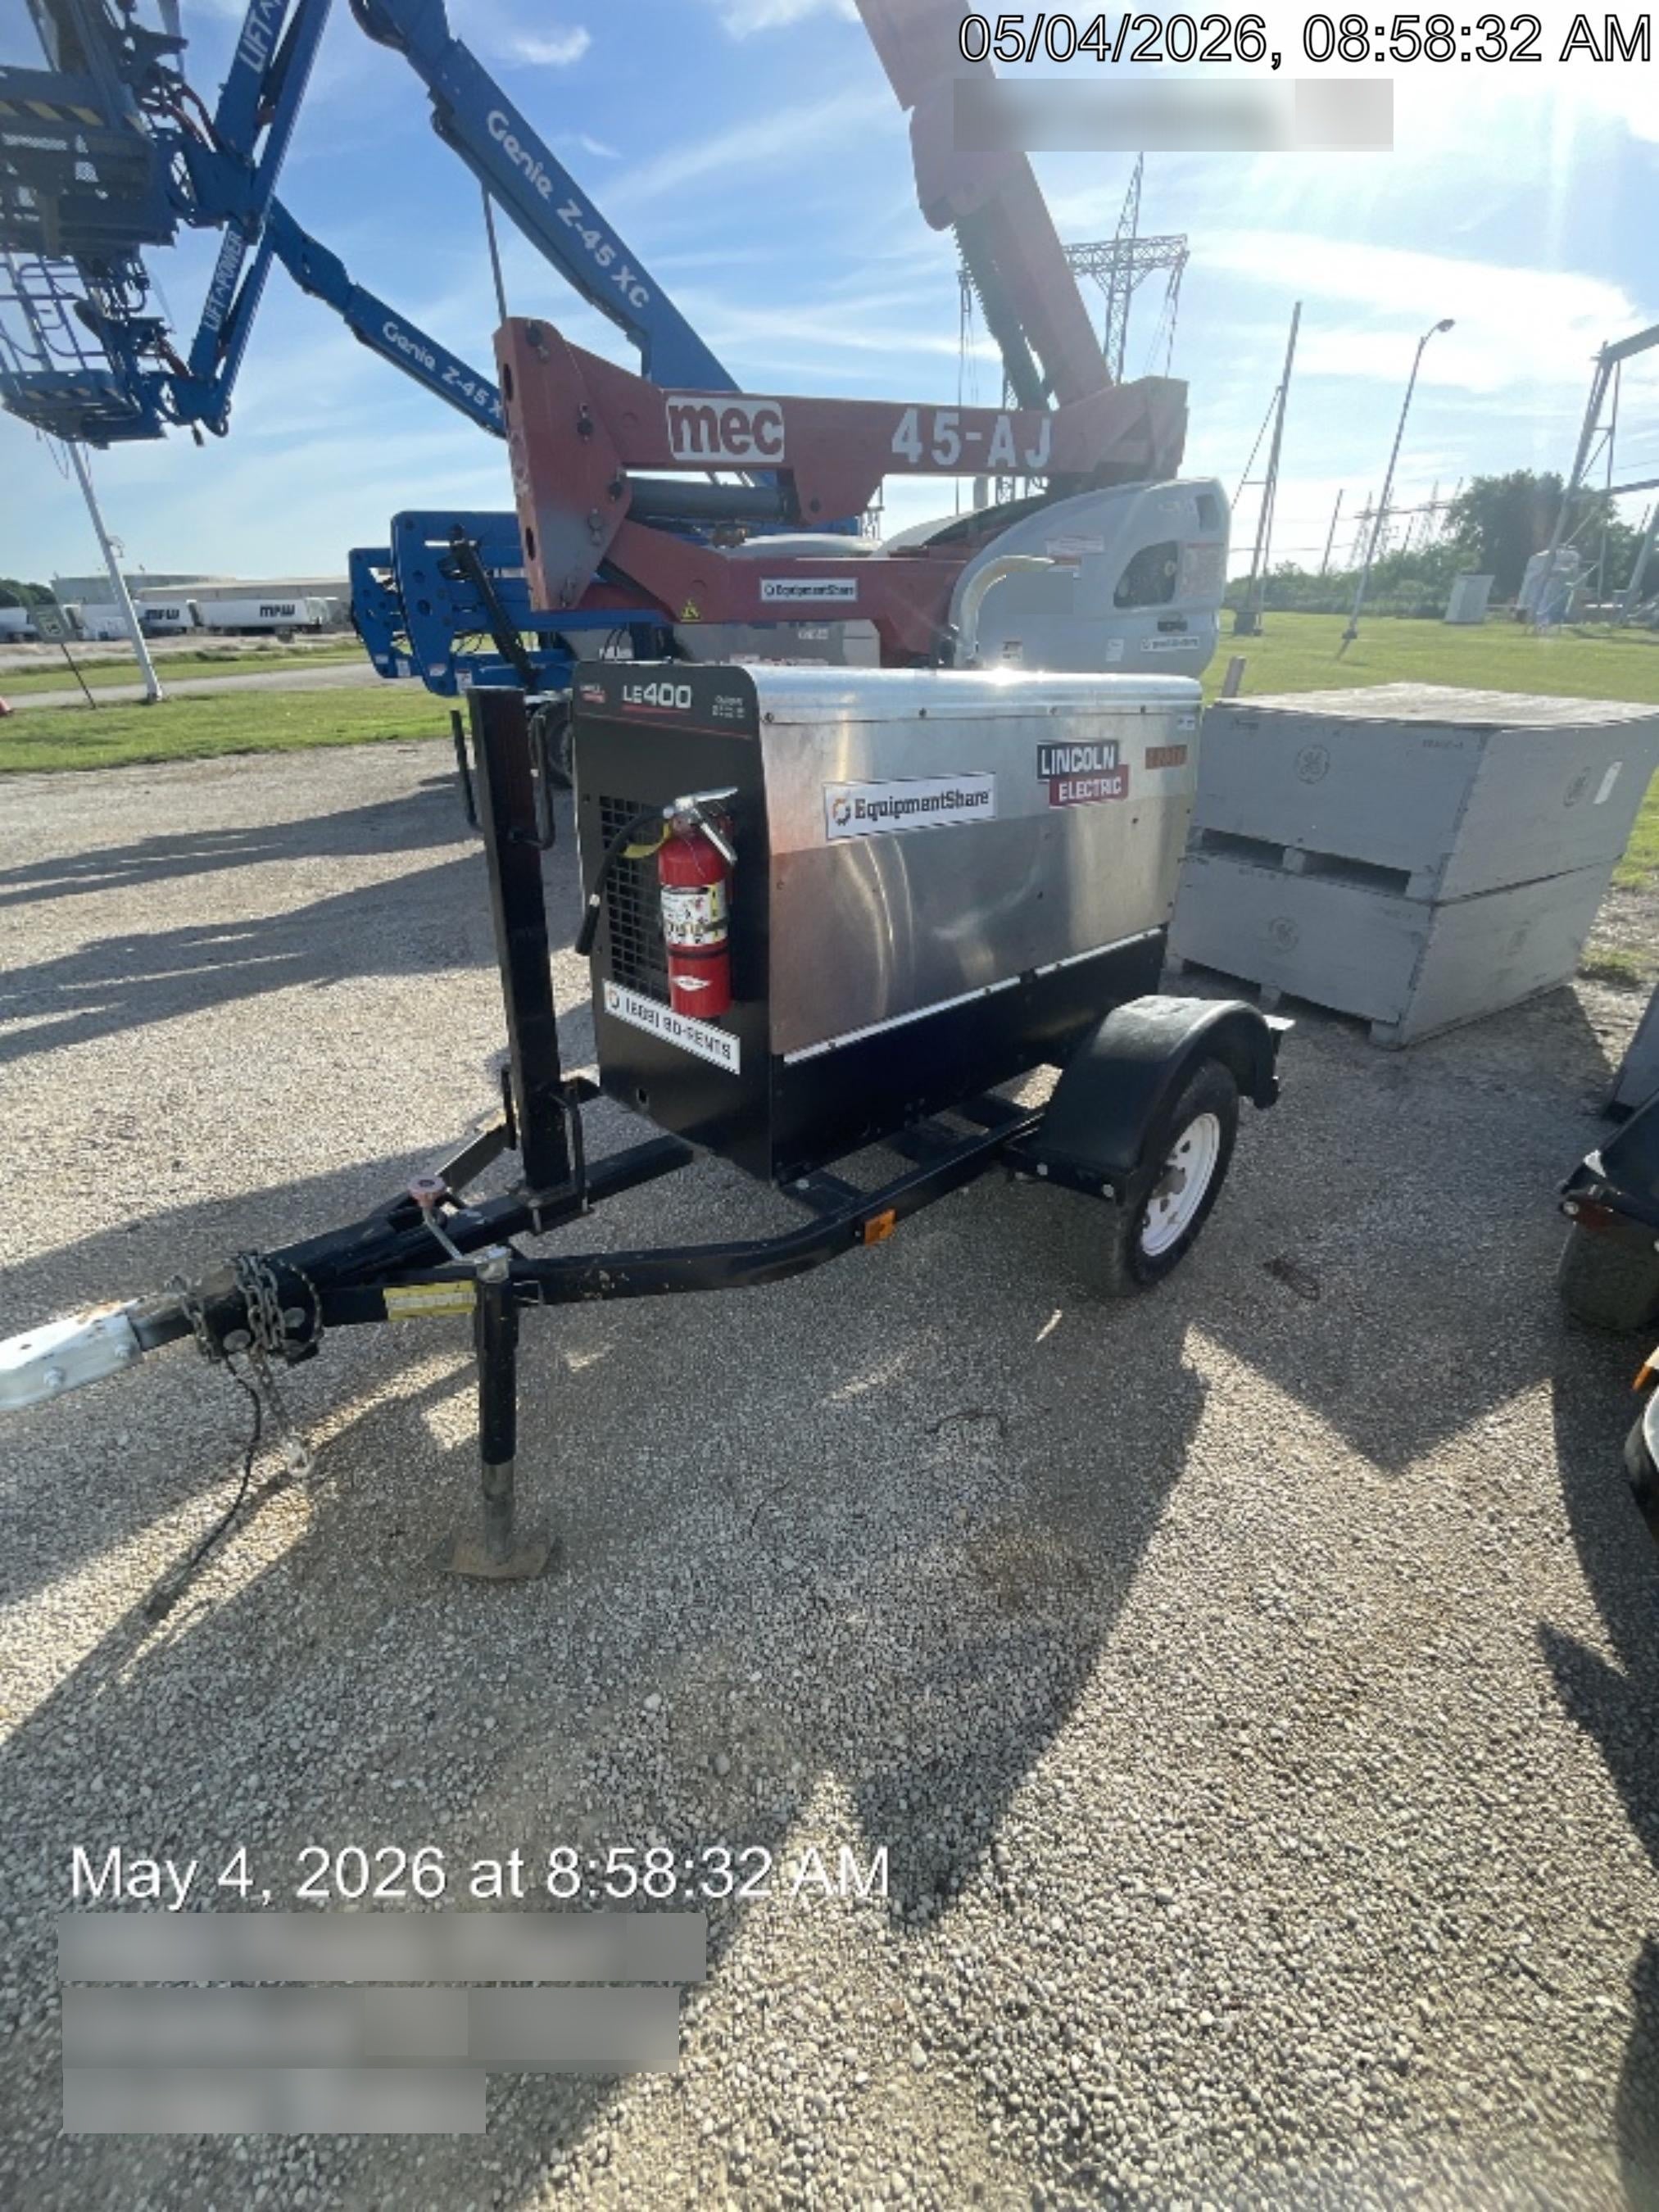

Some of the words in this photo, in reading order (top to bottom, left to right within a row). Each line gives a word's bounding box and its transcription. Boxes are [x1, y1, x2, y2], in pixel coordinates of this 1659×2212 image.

[487, 111, 553, 200] Genie
[557, 198, 616, 266] Z-45
[611, 265, 649, 308] XC
[383, 321, 436, 371] Genie
[442, 365, 489, 406] Z-45
[489, 397, 503, 419] X
[669, 405, 782, 455] mec
[891, 409, 1052, 468] 45-AJ
[623, 682, 691, 709] LE400
[1041, 746, 1115, 775] LINCOLN
[854, 788, 990, 822] EquipmentShare
[1058, 777, 1122, 802] ELECTRIC
